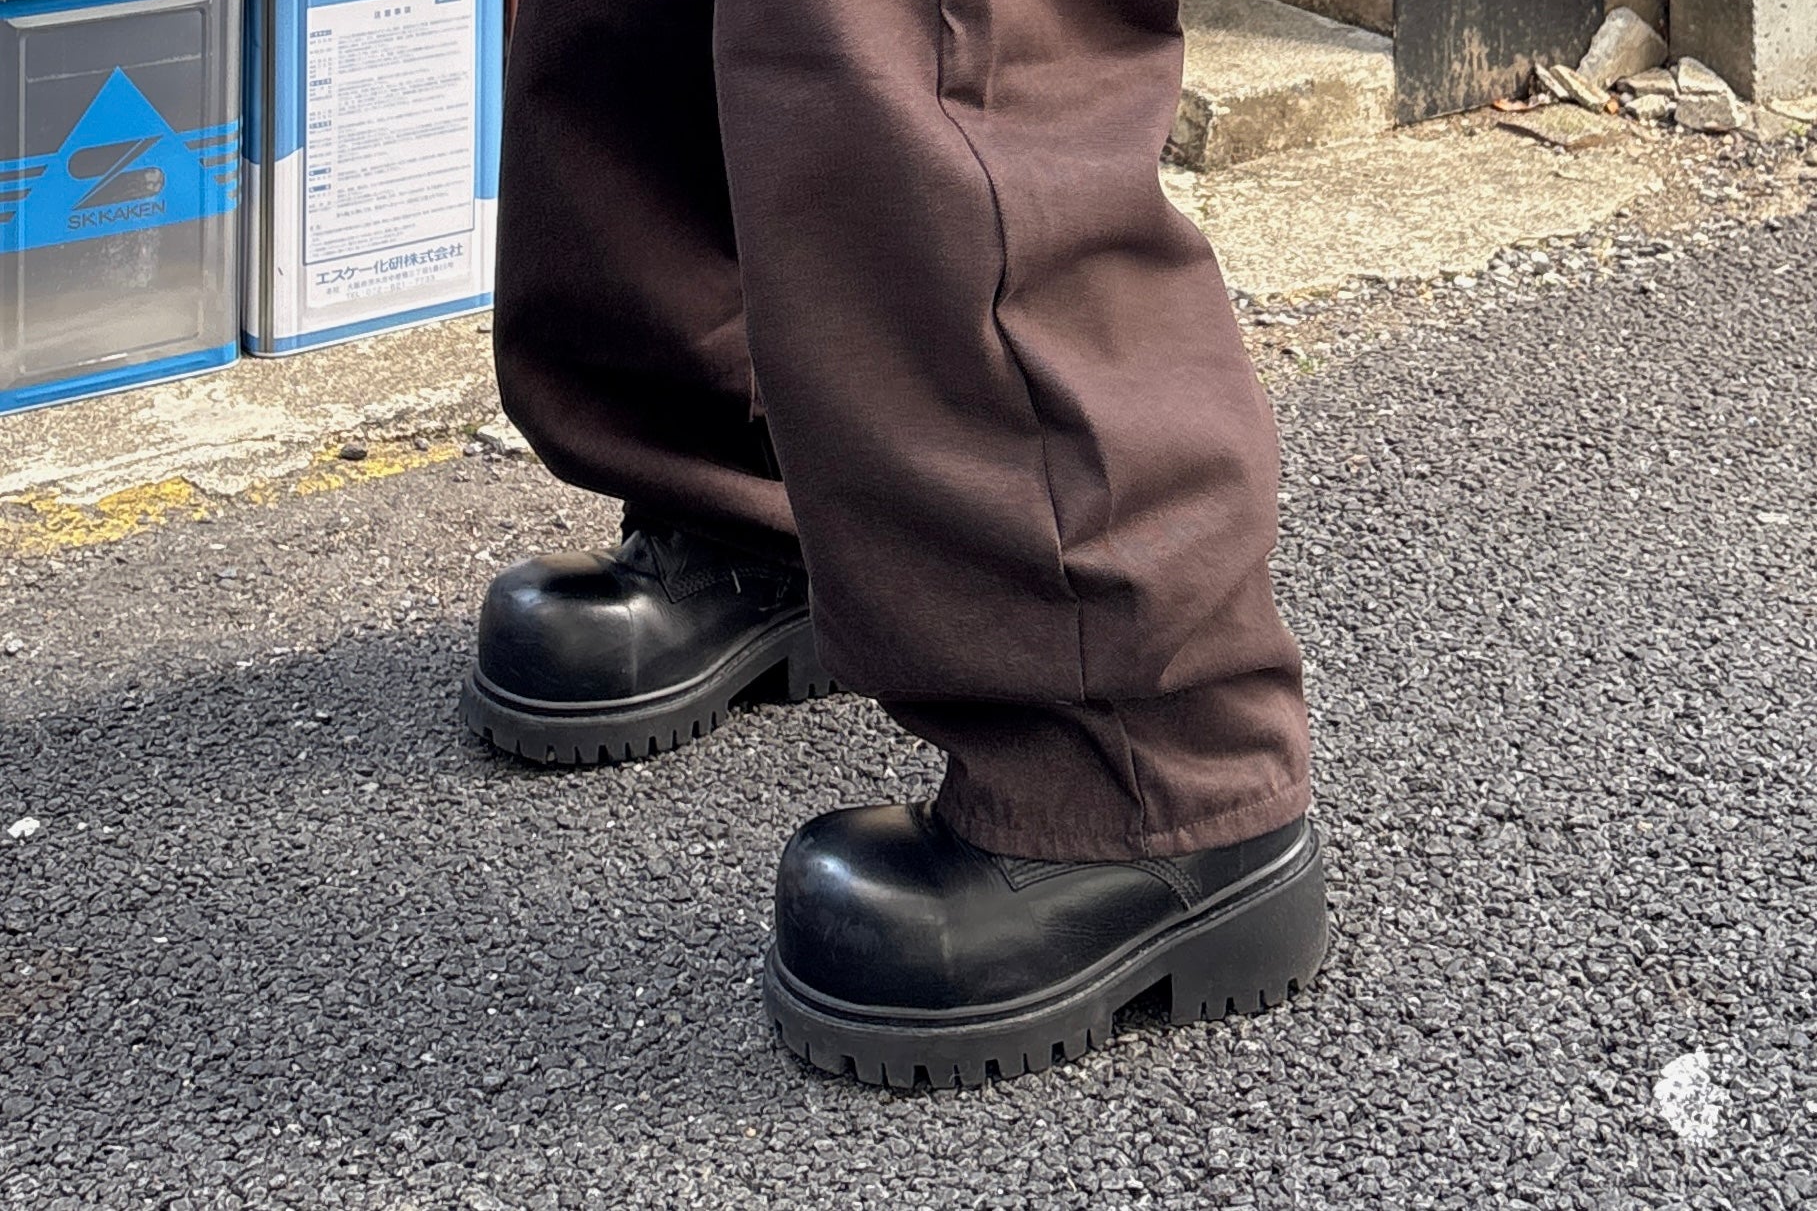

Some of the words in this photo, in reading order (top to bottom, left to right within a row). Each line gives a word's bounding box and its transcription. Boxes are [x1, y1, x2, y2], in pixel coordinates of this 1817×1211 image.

[315, 242, 464, 287] エスケー化研株式会社
